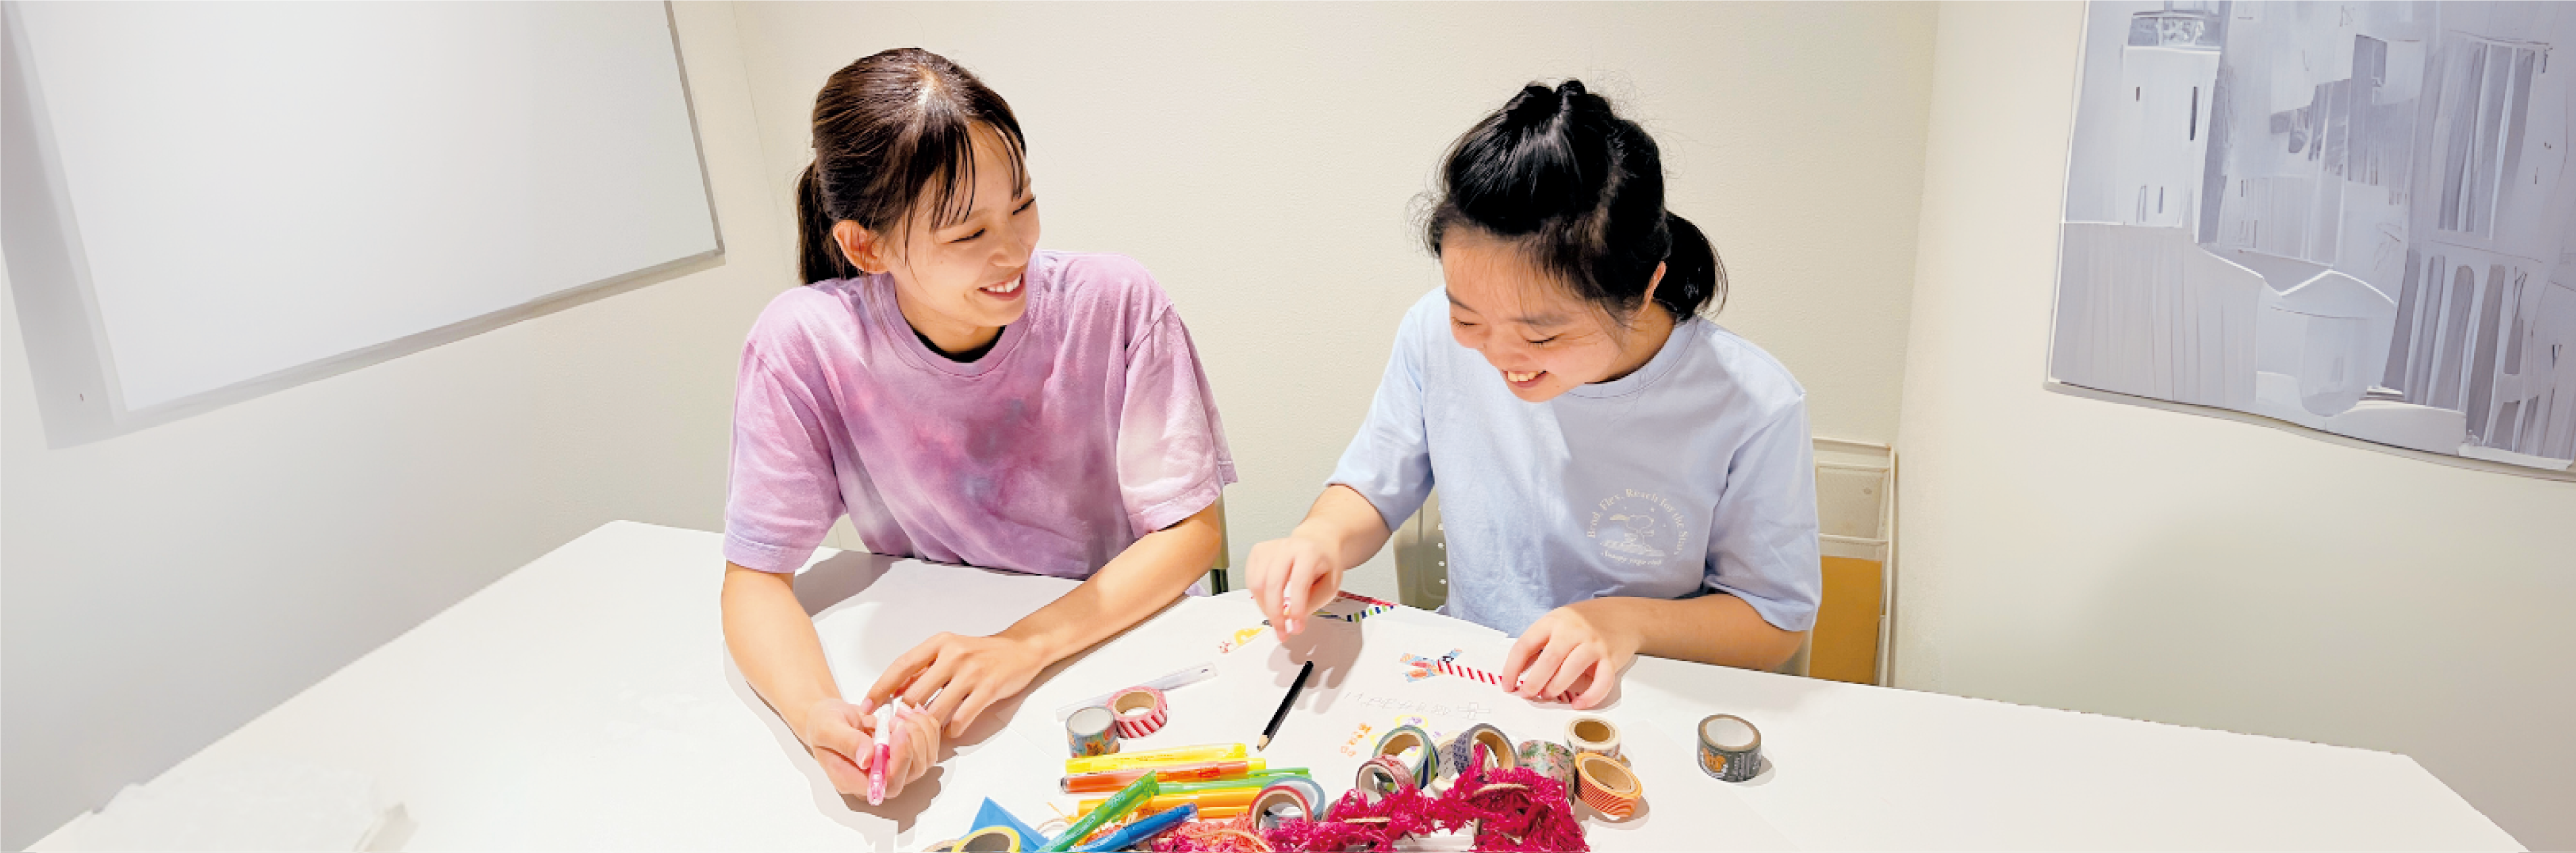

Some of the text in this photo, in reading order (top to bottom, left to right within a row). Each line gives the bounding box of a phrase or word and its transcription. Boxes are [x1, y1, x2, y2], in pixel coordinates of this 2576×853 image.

[1626, 488, 1658, 502] Reach
[1659, 498, 1676, 513] for
[1672, 512, 1684, 529] the
